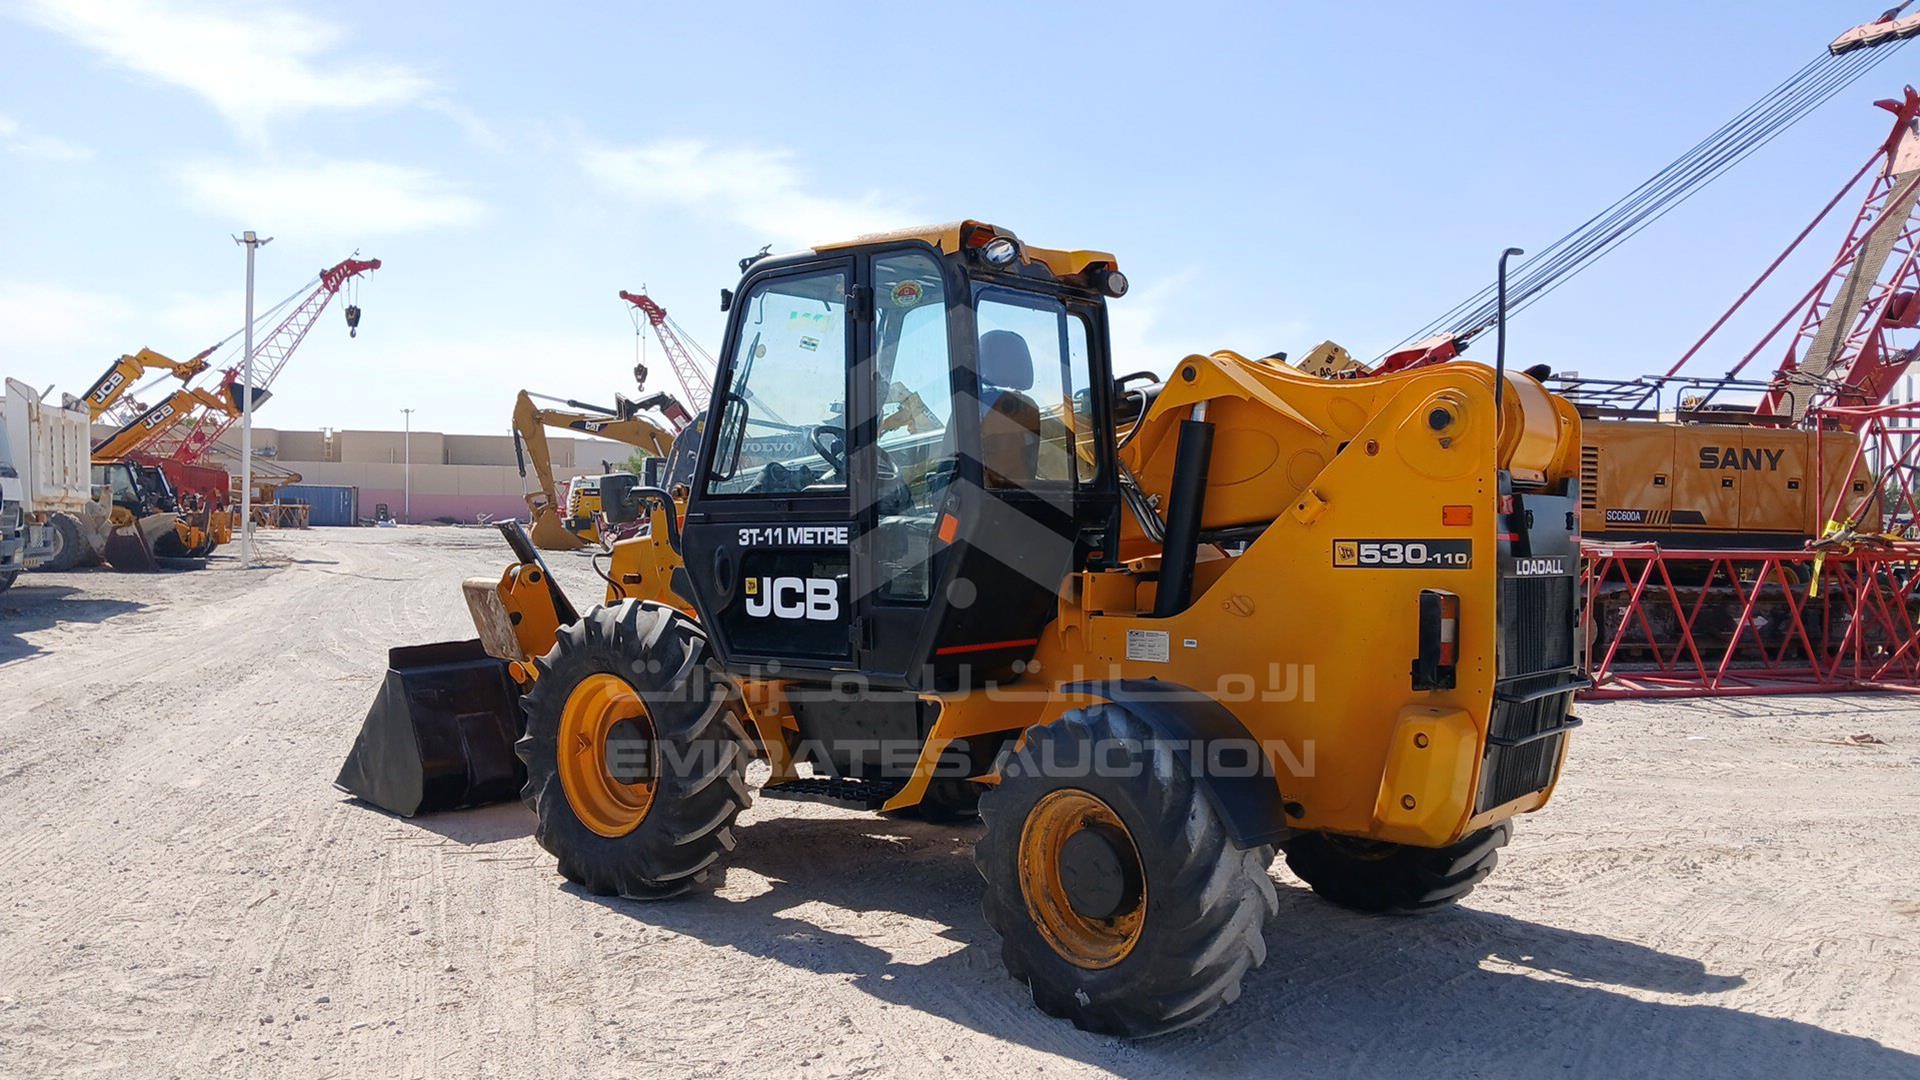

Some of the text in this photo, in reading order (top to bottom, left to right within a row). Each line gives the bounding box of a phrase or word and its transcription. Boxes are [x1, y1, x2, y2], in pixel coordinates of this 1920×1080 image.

[95, 372, 123, 403] JCB
[144, 404, 174, 429] JCB
[1699, 447, 1785, 471] SANY
[1606, 510, 1641, 521] SCC600A
[739, 526, 849, 546] 3T-11 METRE
[1359, 542, 1468, 565] 530-110
[1516, 559, 1564, 576] LOADALL
[745, 576, 839, 621] JCB
